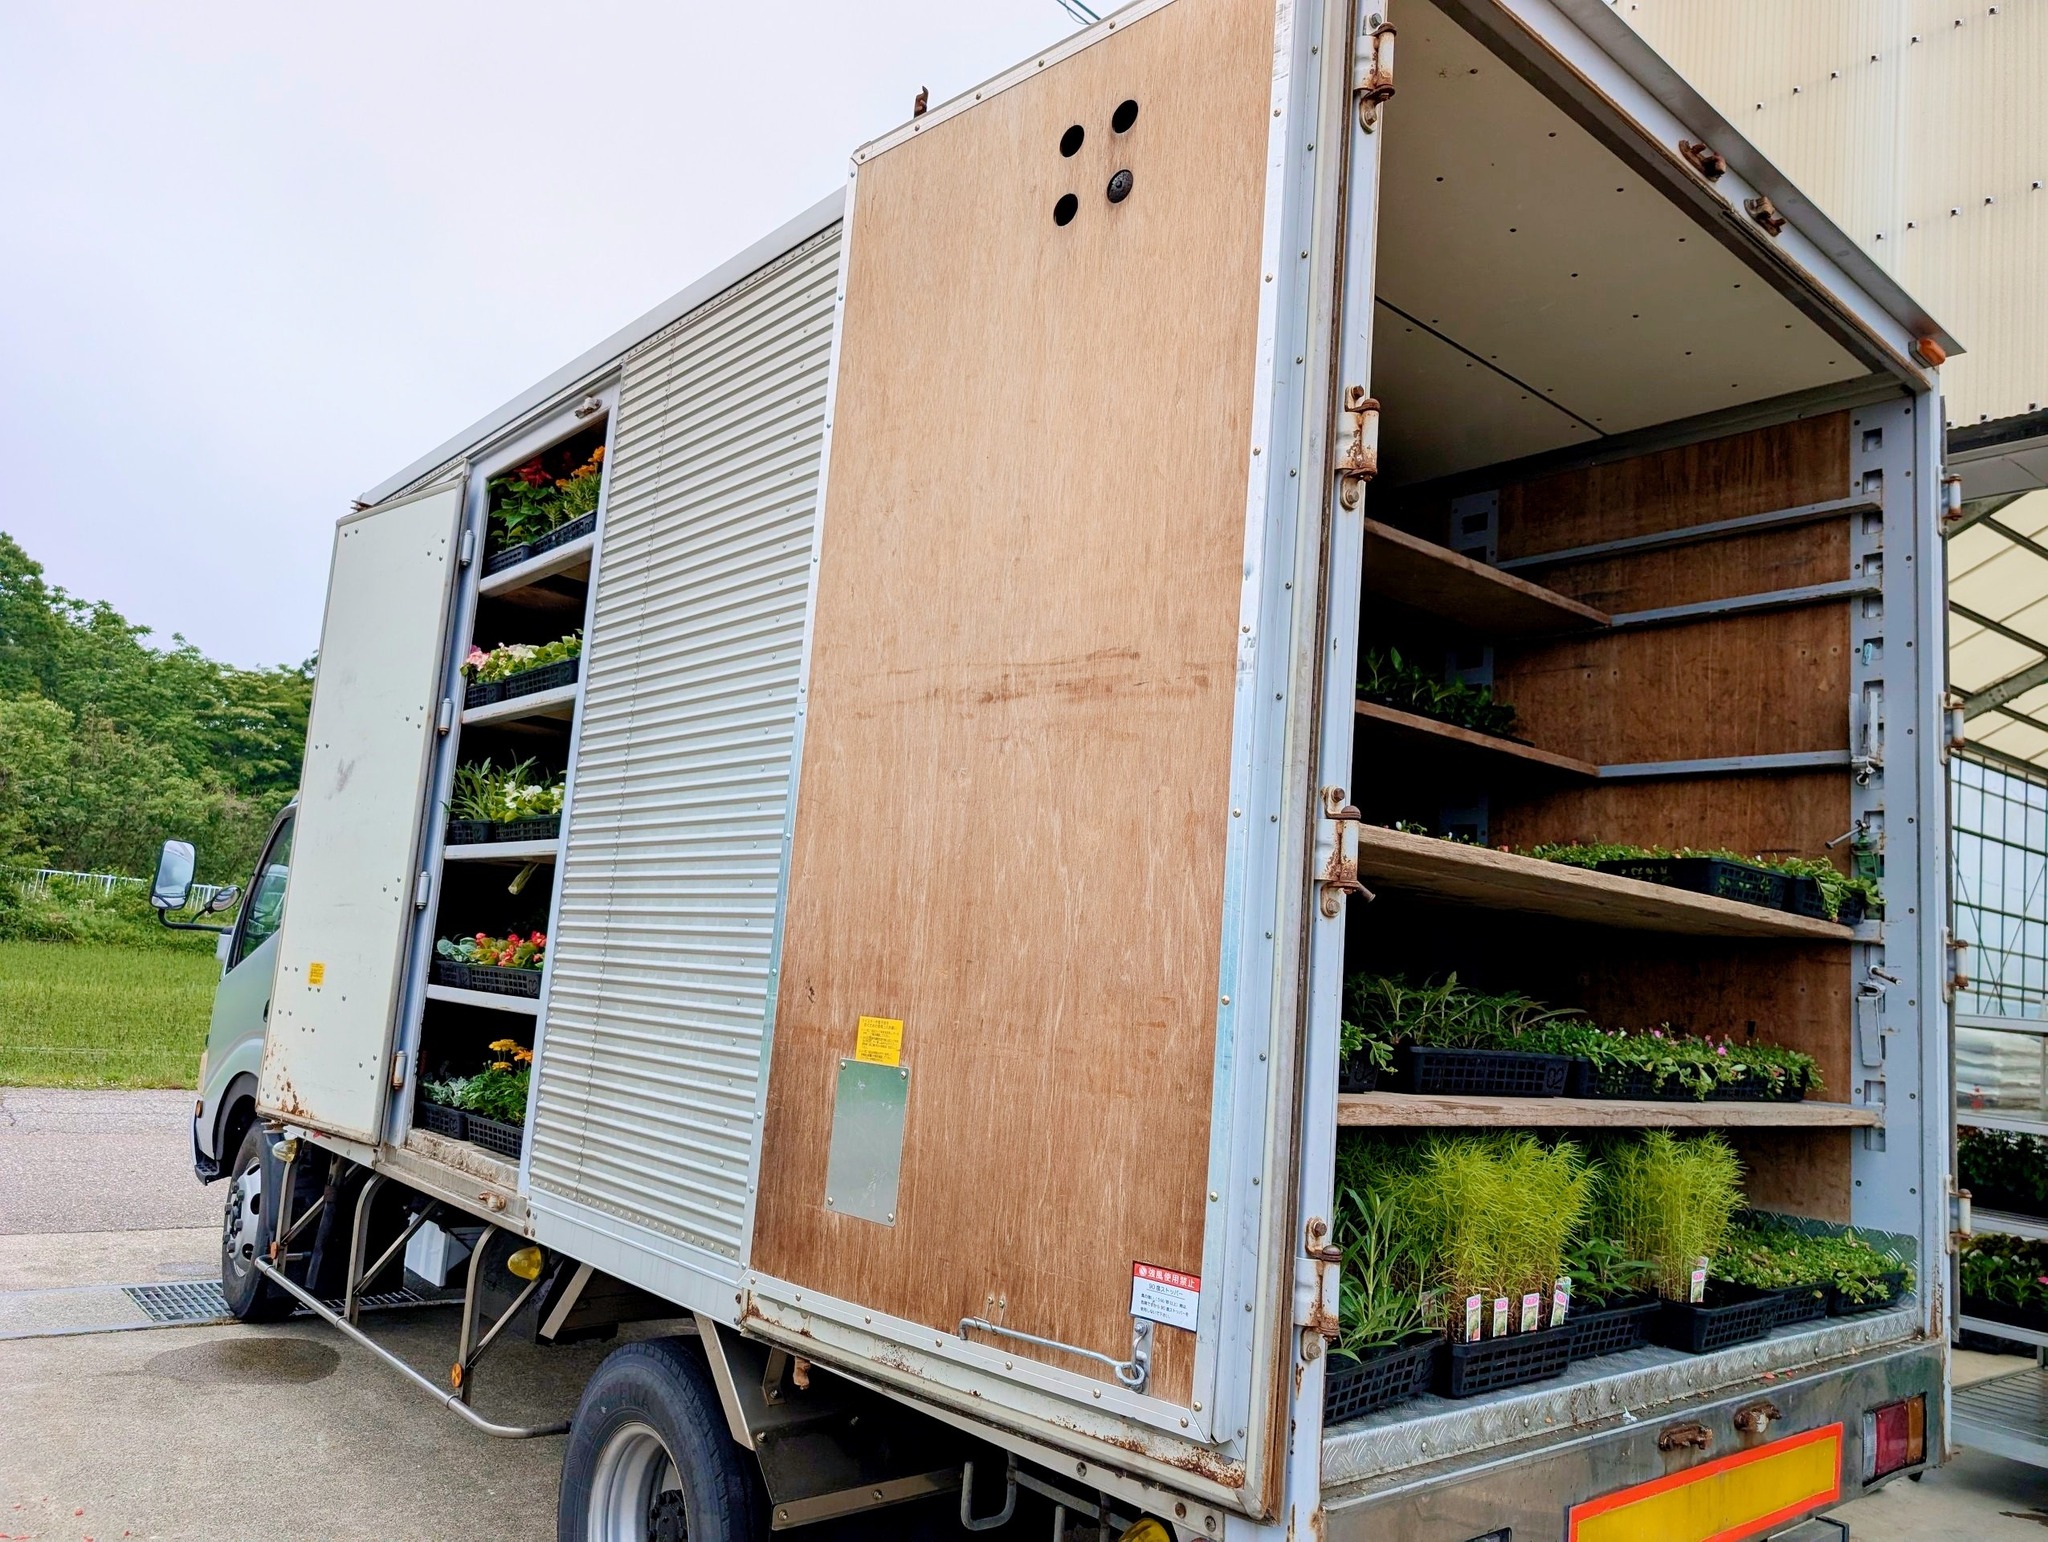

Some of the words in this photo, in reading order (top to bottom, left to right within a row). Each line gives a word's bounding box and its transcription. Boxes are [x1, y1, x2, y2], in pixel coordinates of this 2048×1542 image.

[1148, 1267, 1195, 1288] 強風使用禁止
